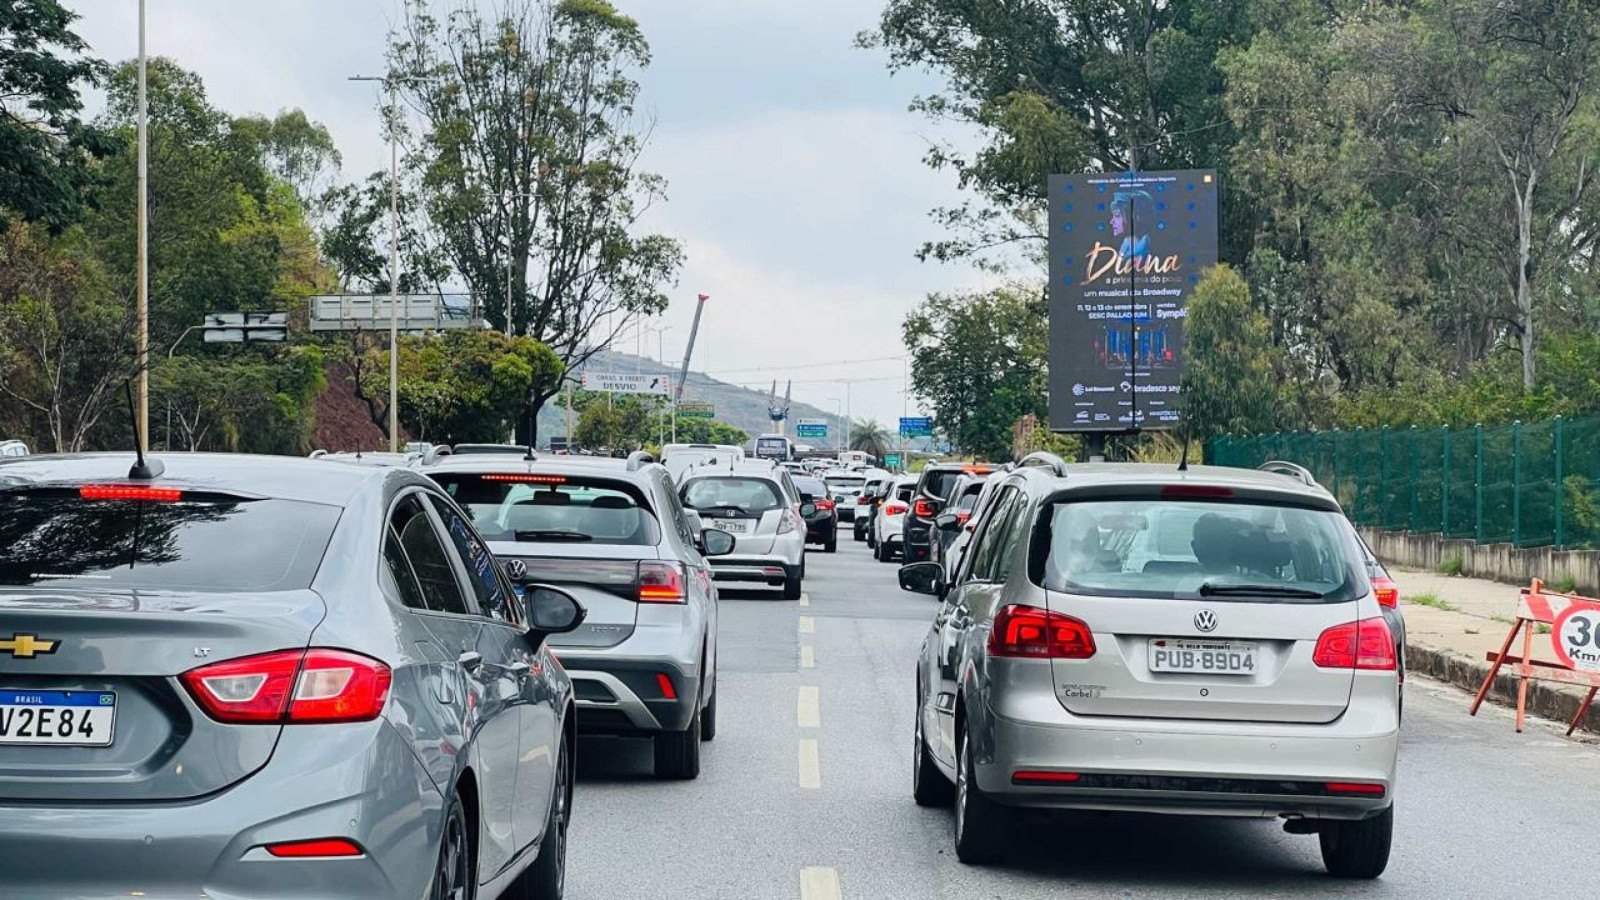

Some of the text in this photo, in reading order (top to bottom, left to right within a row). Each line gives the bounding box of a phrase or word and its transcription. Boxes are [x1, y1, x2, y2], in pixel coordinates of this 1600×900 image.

[1081, 241, 1180, 286] Diana
[1150, 275, 1161, 283] do
[1098, 288, 1128, 297] musical
[1143, 287, 1181, 296] Broadway
[603, 382, 637, 390] DESVIO
[1134, 382, 1167, 392] bradesco
[1567, 616, 1600, 649] 3
[194, 646, 211, 658] LT
[1064, 689, 1093, 699] Carbel
[15, 695, 43, 704] BRASIL
